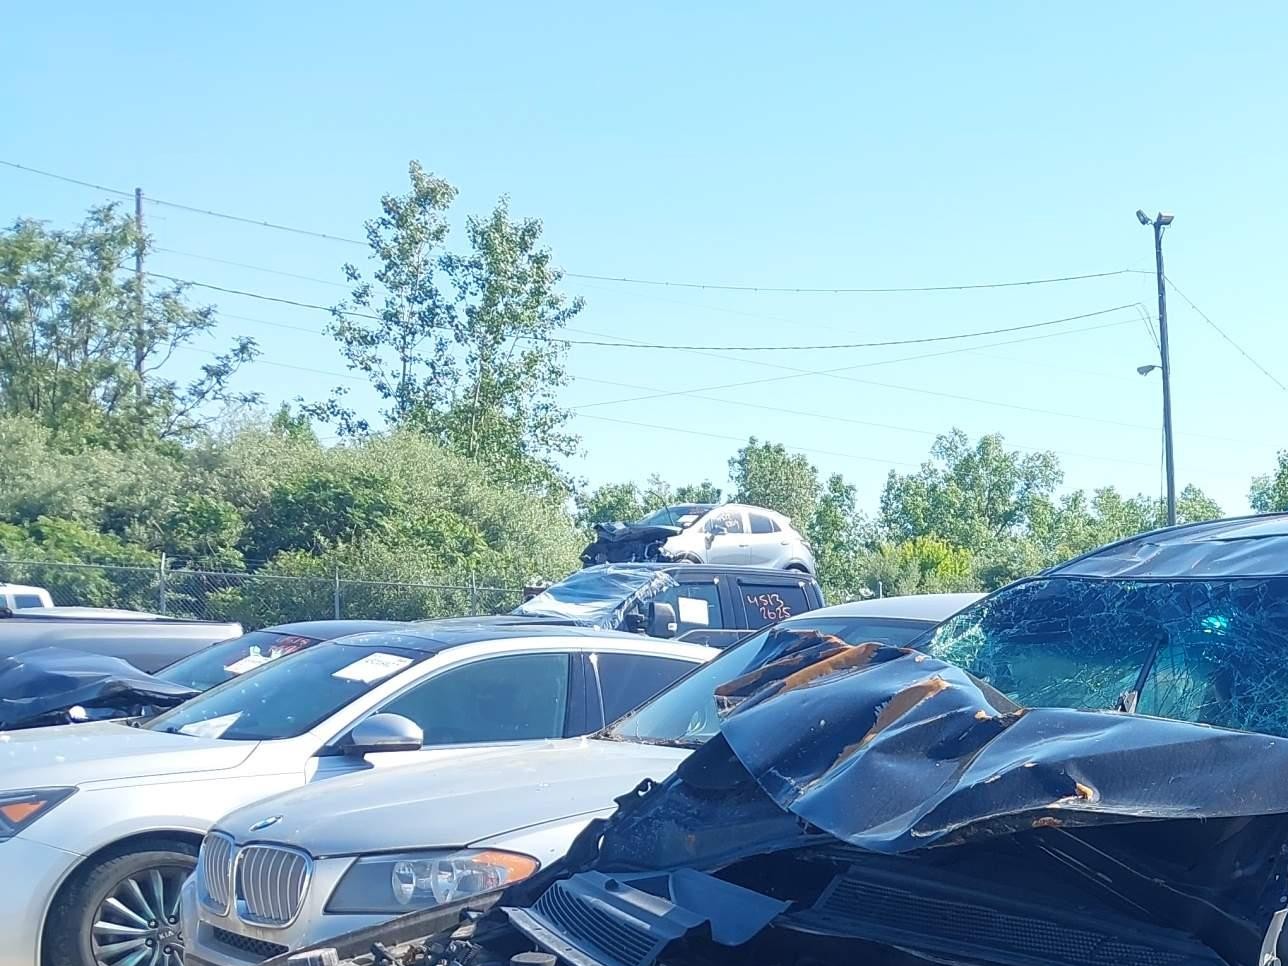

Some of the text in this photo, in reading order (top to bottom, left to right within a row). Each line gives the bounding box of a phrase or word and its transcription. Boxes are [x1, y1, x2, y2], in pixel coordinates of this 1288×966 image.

[746, 594, 784, 607] 4513
[760, 606, 791, 619] 2625
[158, 930, 174, 940] KIA
